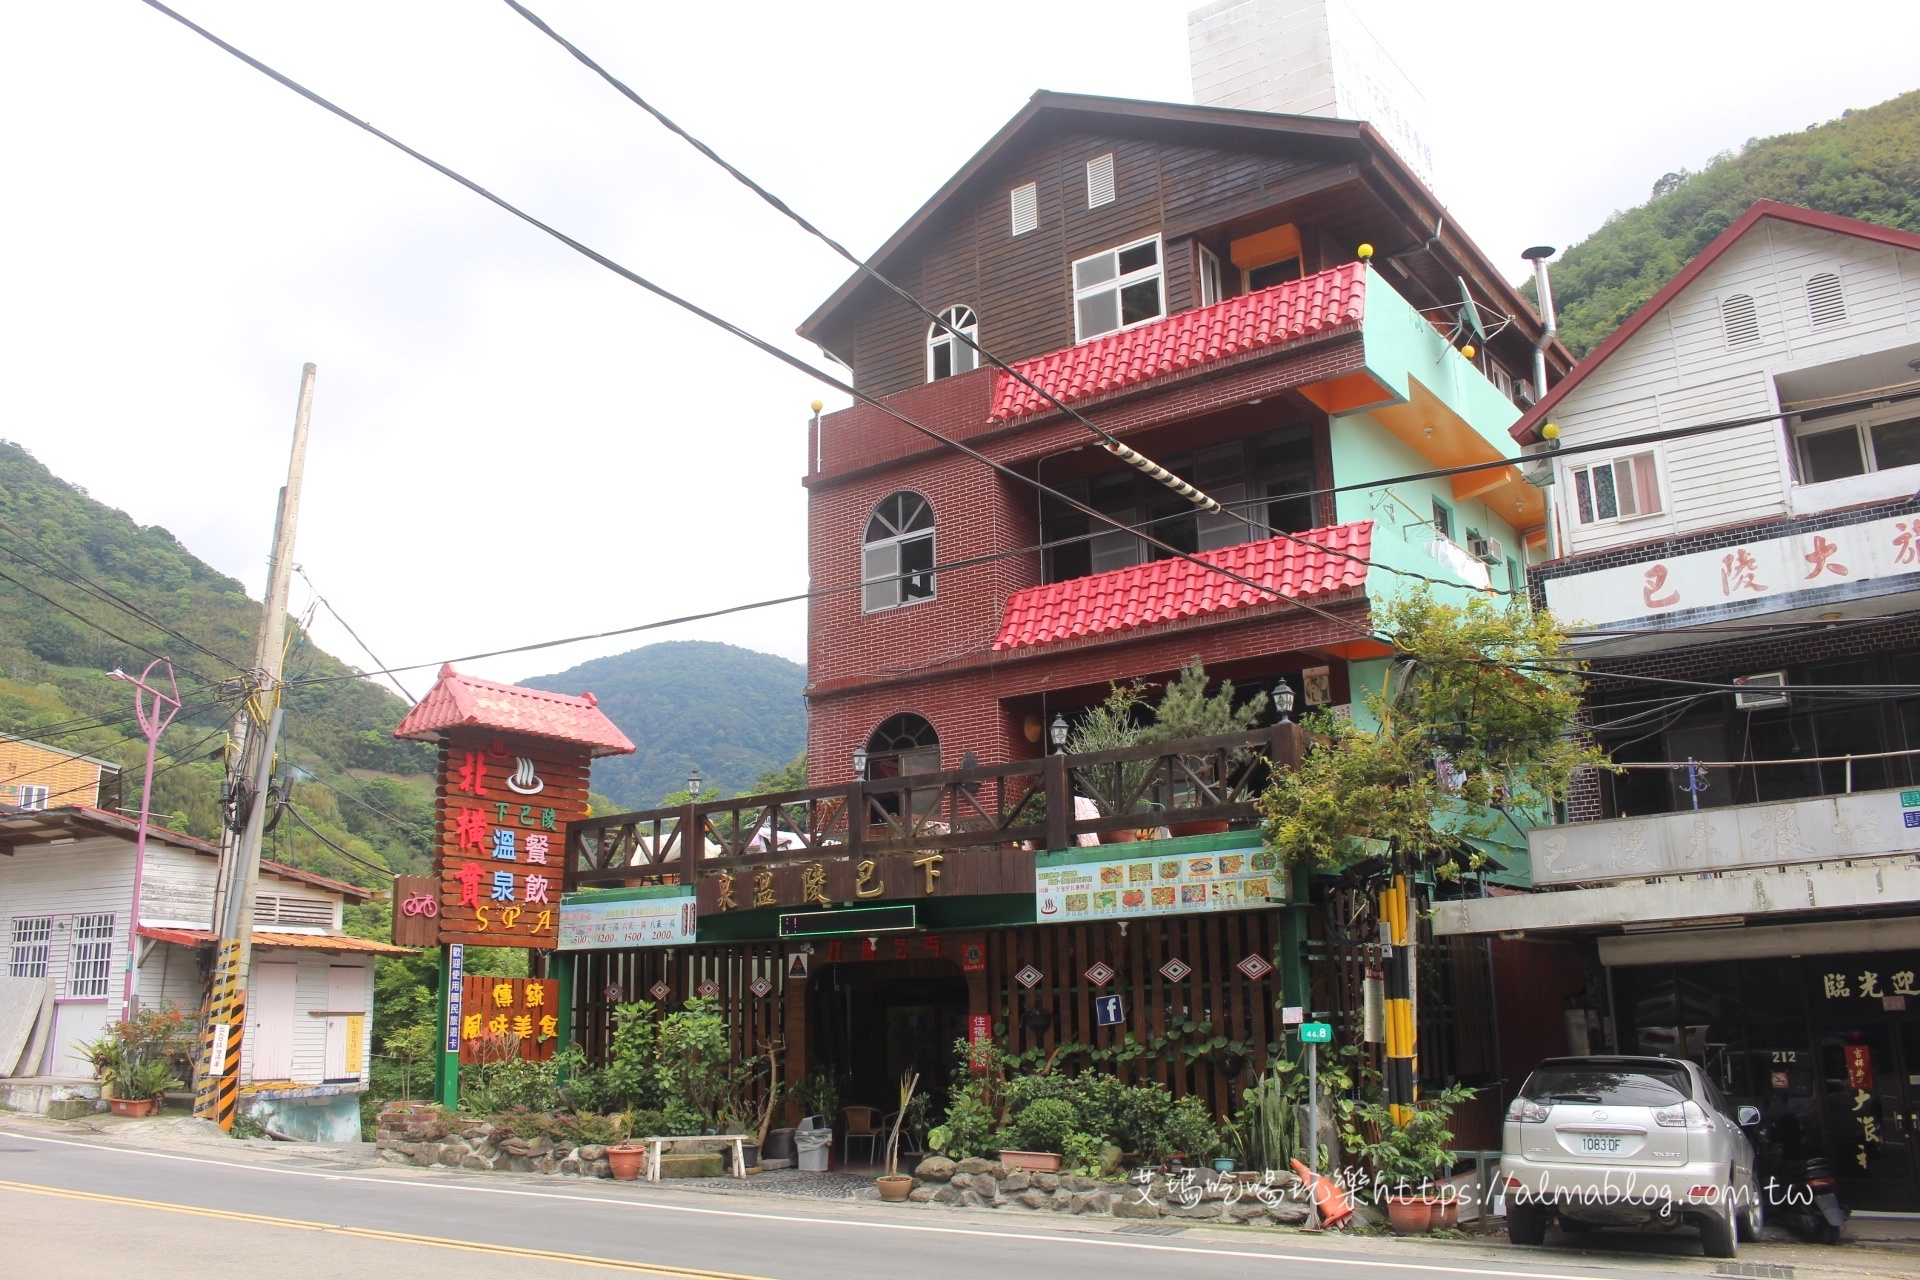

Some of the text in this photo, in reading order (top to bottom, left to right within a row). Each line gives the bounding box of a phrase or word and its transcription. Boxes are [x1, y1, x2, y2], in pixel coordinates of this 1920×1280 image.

[491, 827, 517, 902] 溫泉
[524, 833, 550, 905] 餐飲
[475, 905, 553, 934] SPA
[492, 982, 545, 1008] 傳統
[462, 1012, 559, 1040] 風味美食
[1306, 1028, 1327, 1038] 46.8
[1772, 1051, 1797, 1063] 212
